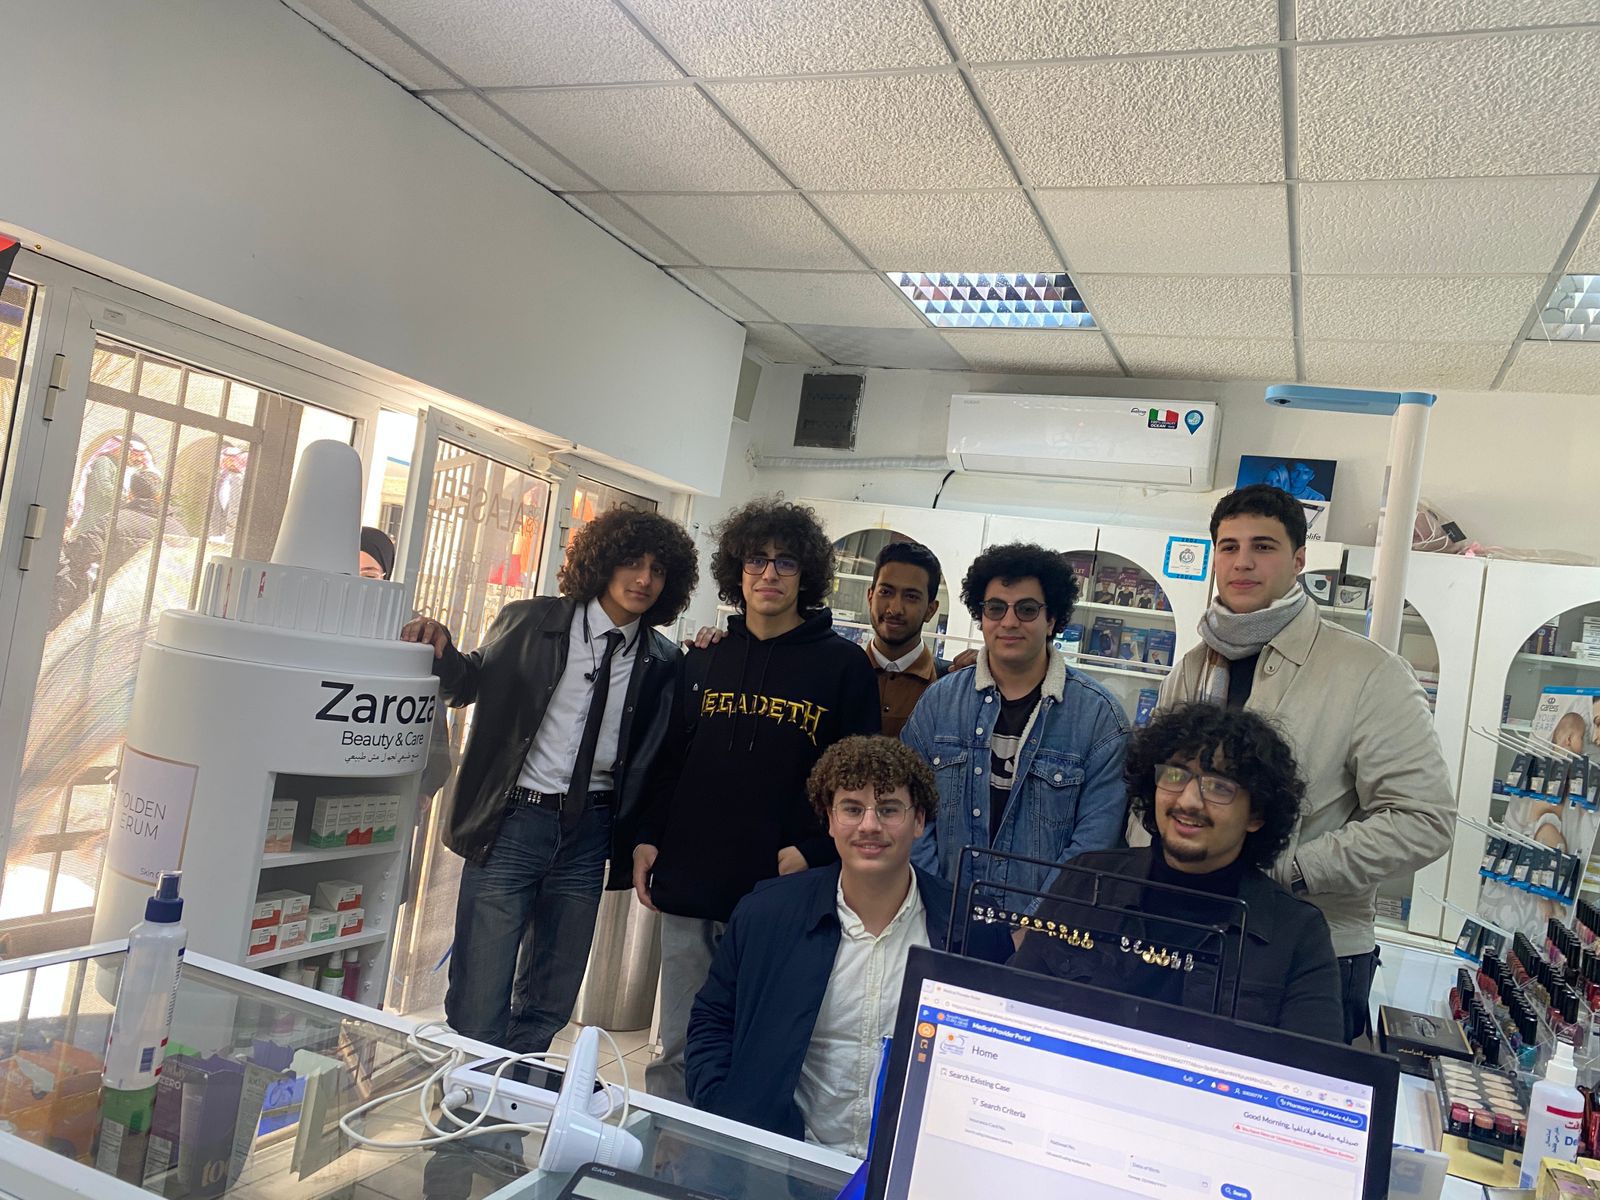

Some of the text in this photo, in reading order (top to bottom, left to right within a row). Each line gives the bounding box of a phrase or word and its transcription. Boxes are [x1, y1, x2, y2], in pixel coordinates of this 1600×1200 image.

[341, 730, 424, 750] Beauty & Care
[344, 752, 367, 764] طبيعي
[122, 792, 167, 820] OLDEN
[120, 812, 159, 840] ERUM
[972, 1022, 991, 1034] Medical
[991, 1027, 1014, 1039] Provider
[1014, 1032, 1032, 1042] Portal
[971, 1045, 999, 1060] Home
[949, 1070, 1010, 1093] Search Existing Case
[980, 1100, 1026, 1119] Search Criteria
[1243, 1111, 1261, 1121] Good
[591, 1166, 616, 1177] CASIO
[1232, 1190, 1247, 1198] Search
